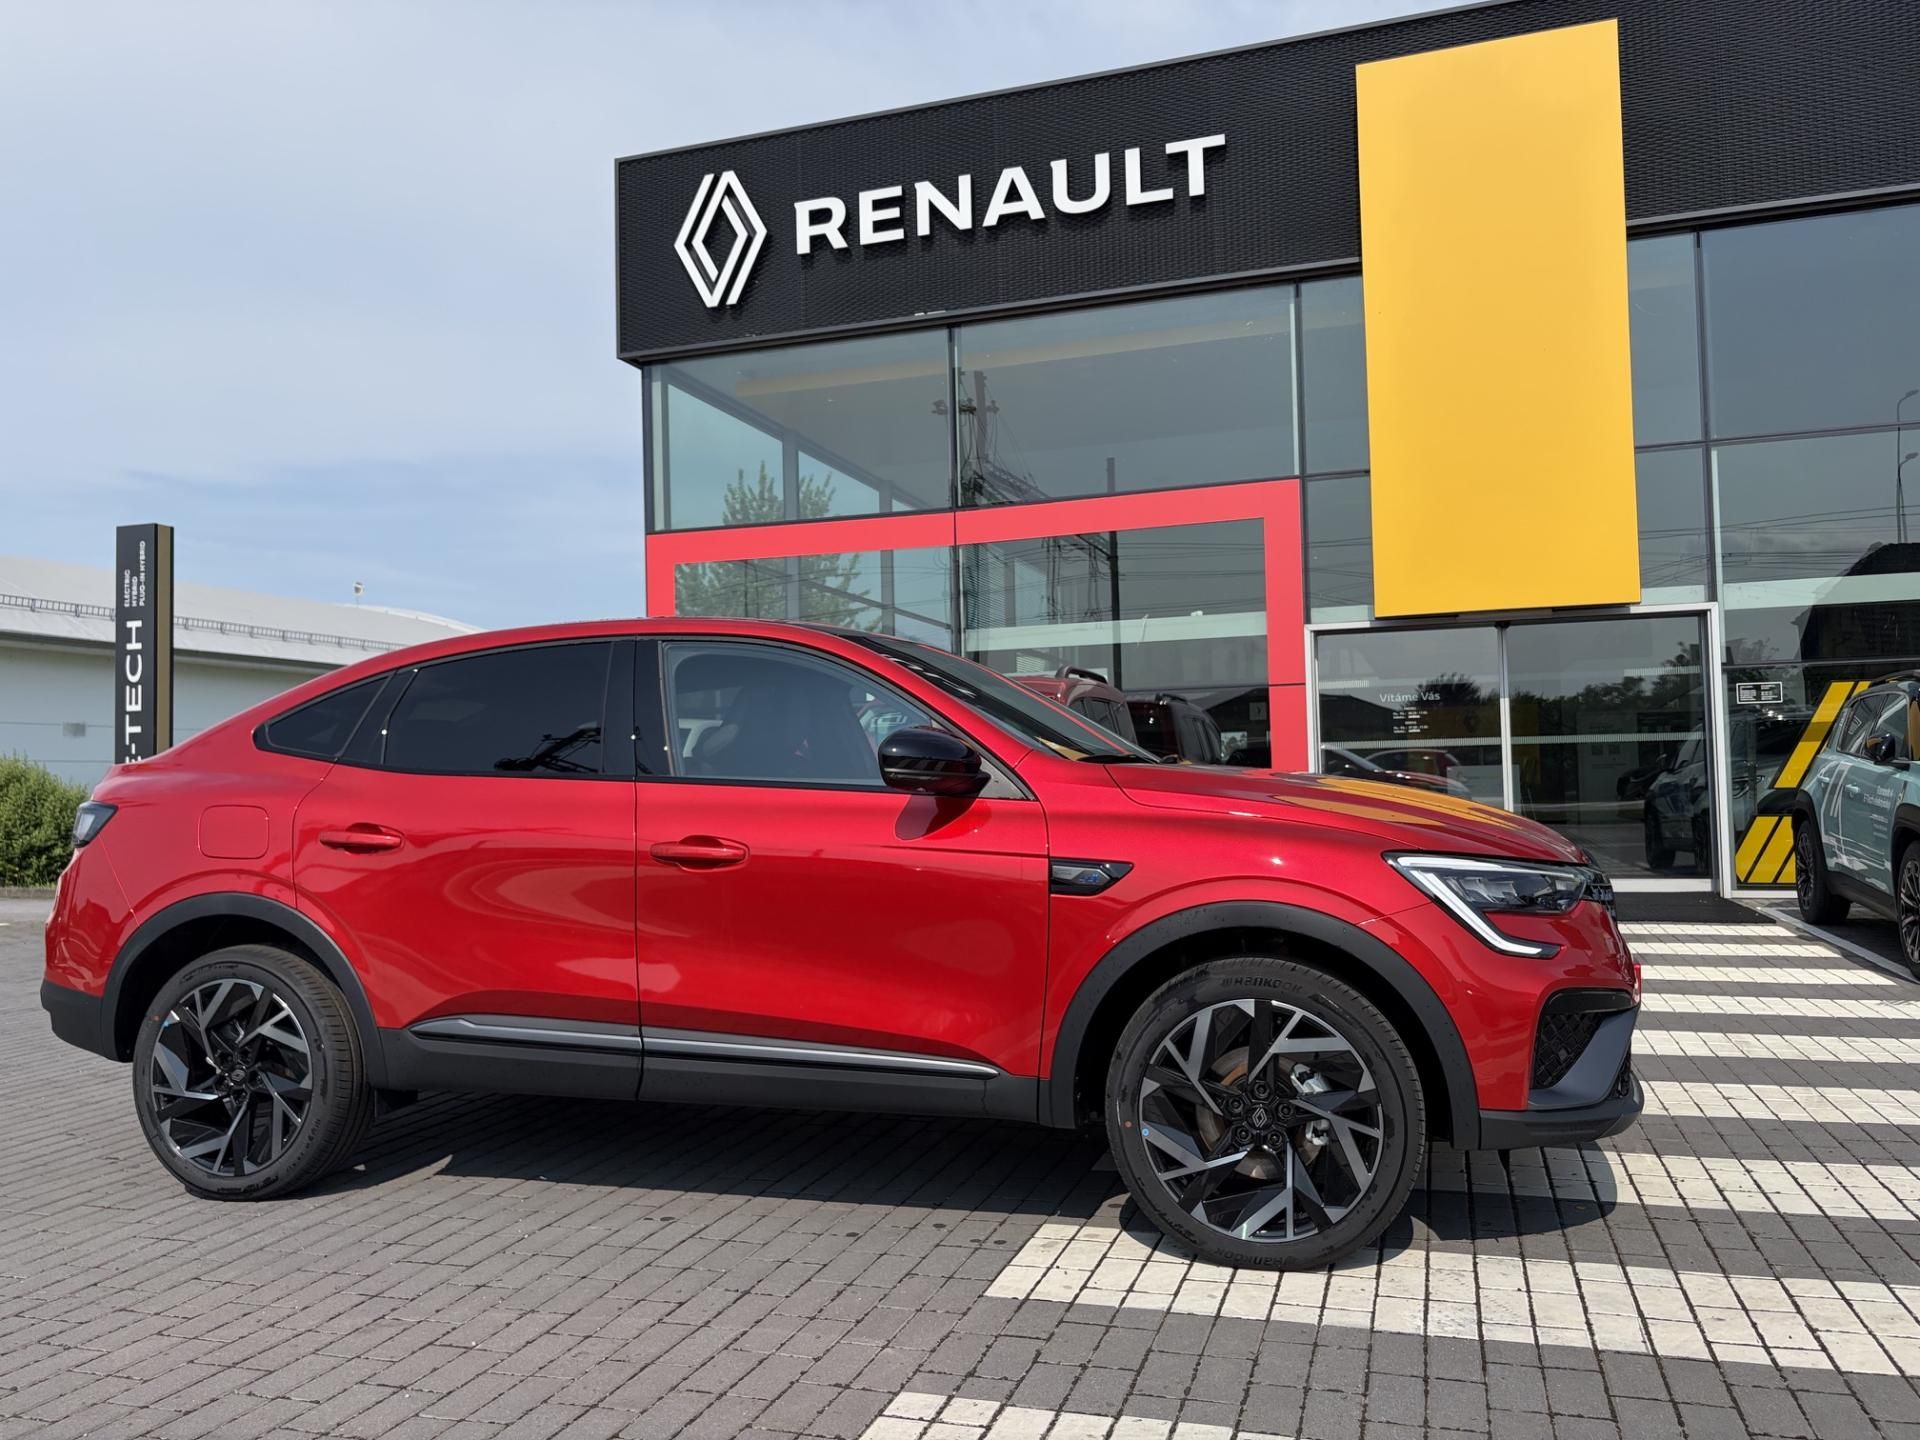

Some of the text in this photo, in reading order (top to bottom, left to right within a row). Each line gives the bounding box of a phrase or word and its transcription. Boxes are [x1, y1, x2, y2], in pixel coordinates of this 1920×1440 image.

[795, 134, 1226, 255] RENAULT
[125, 620, 143, 762] -TECH
[1379, 692, 1441, 703] Vitáme Vás
